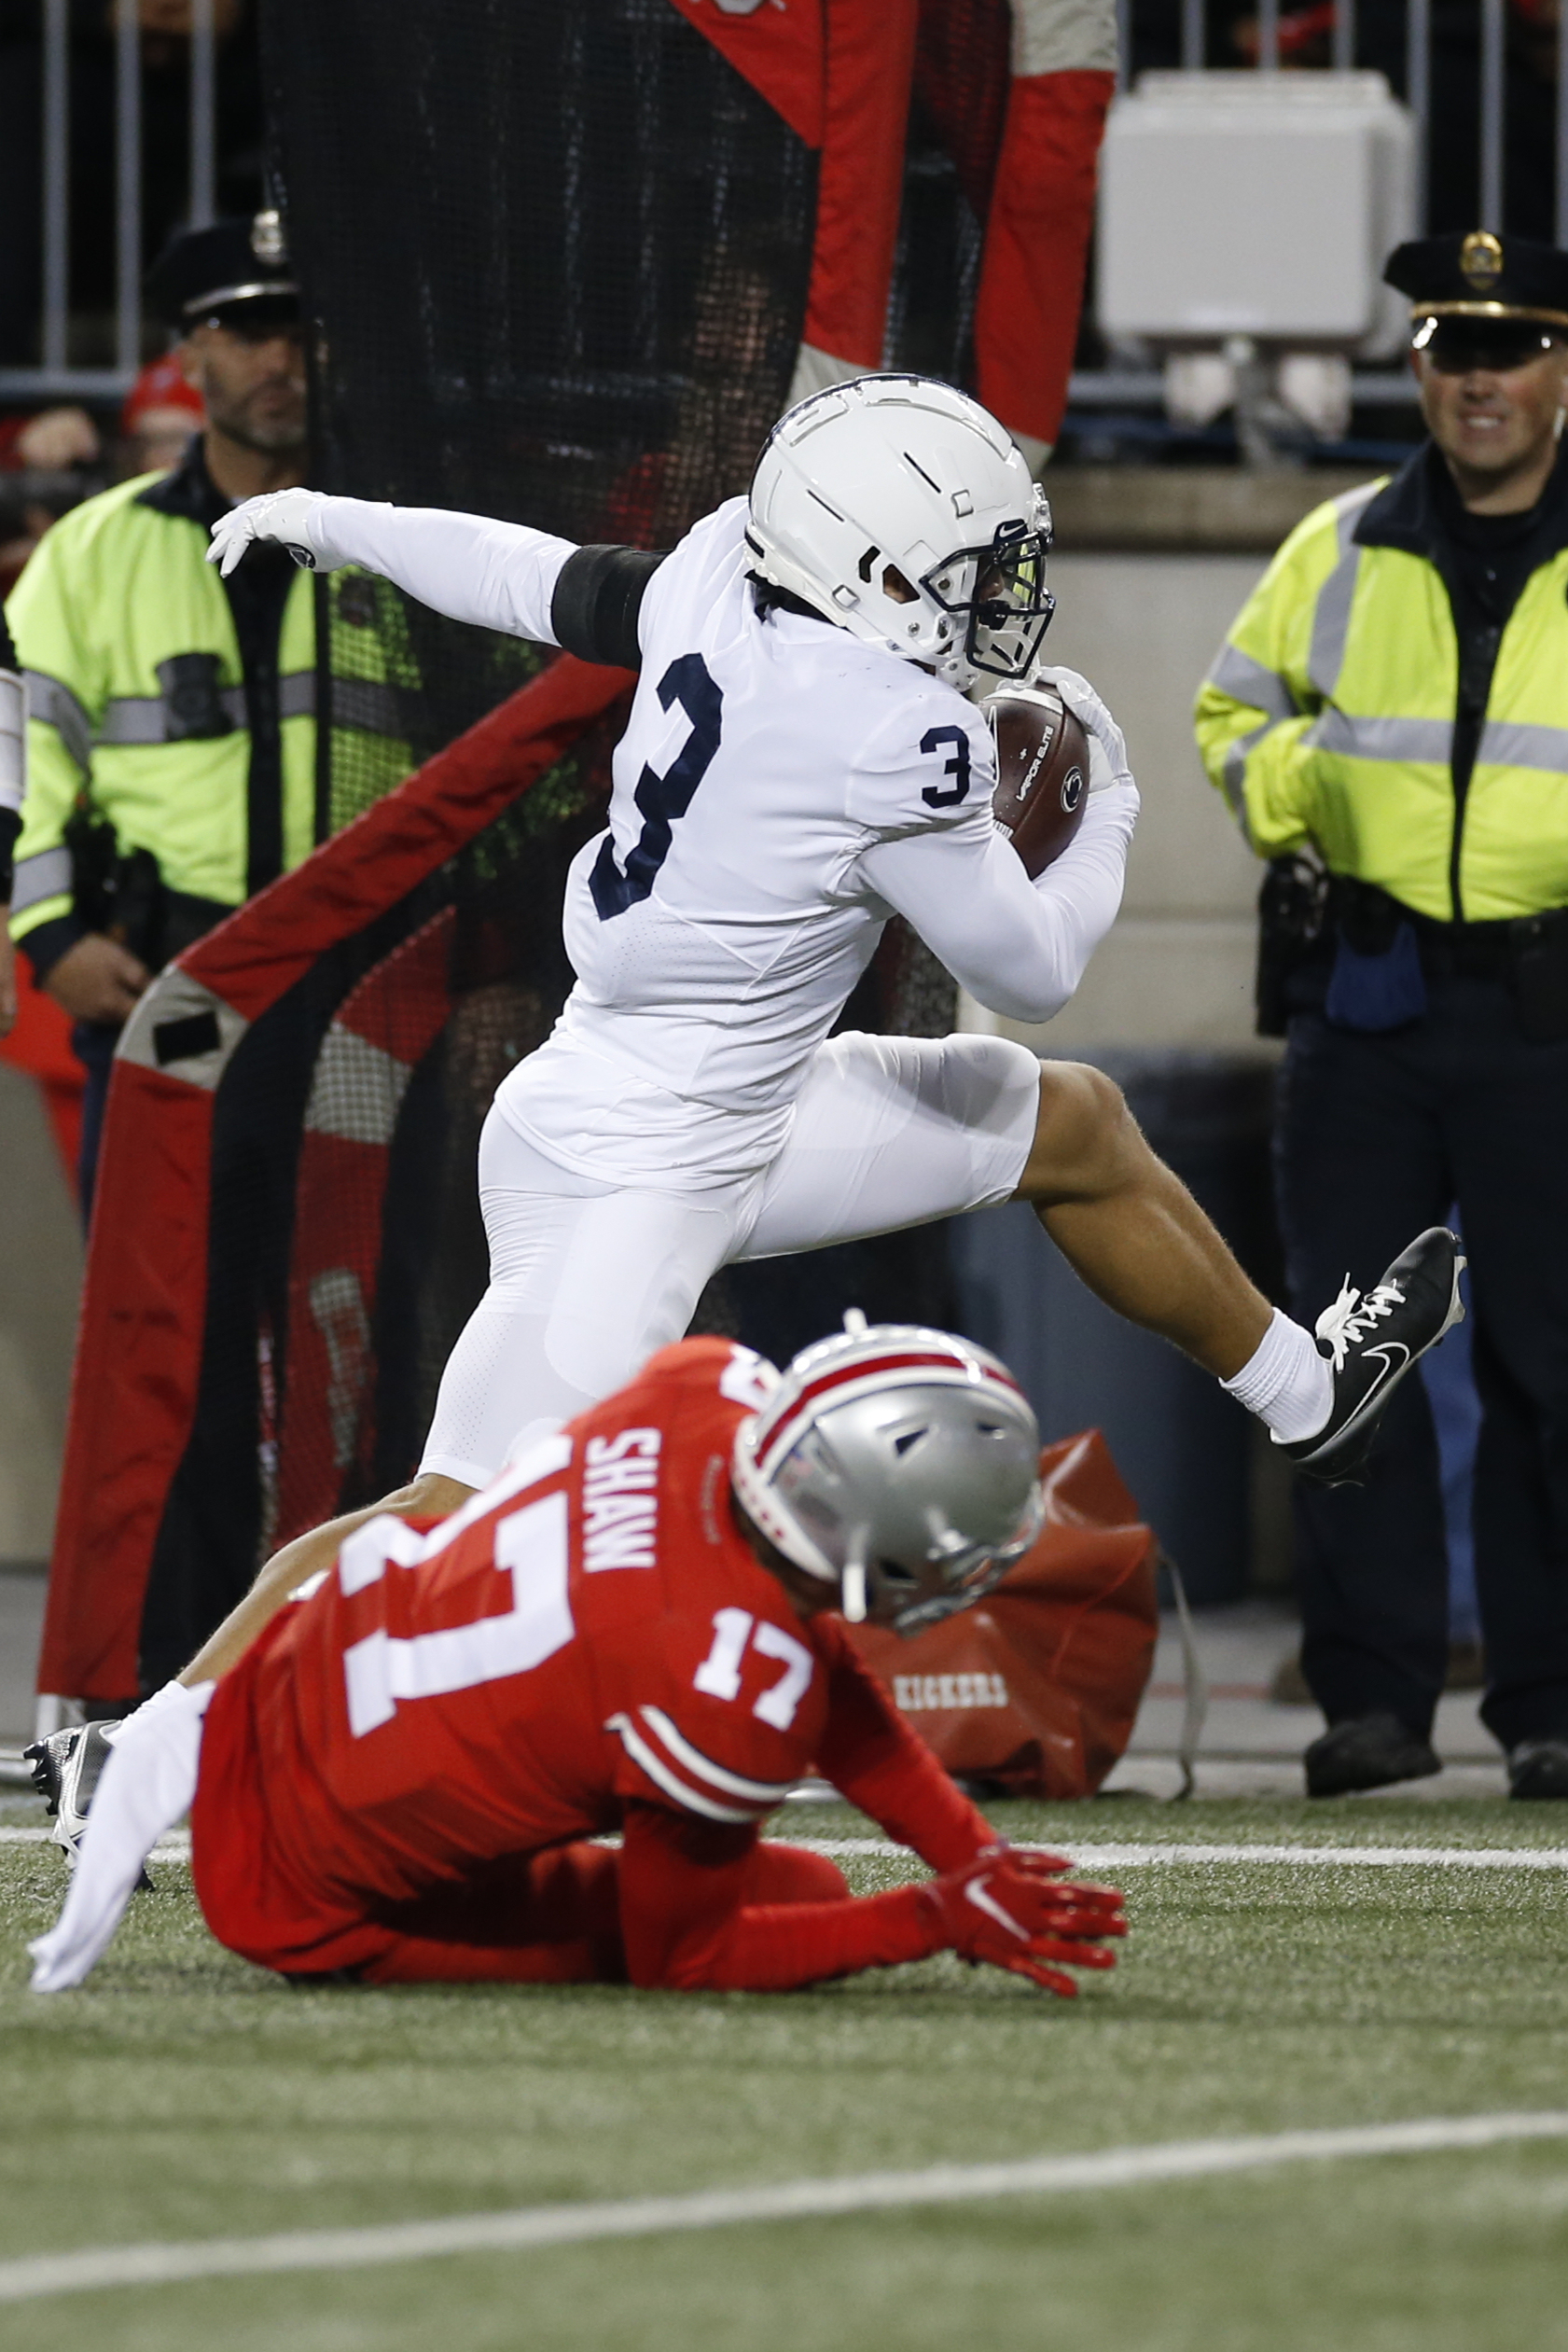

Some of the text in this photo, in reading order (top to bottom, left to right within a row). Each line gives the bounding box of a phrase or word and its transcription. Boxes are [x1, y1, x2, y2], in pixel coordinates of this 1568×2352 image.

[588, 651, 724, 922] 3
[919, 724, 972, 809] 3
[1016, 725, 1053, 800] VAPOR ELITE
[582, 1427, 661, 1574] SHAW
[340, 1433, 576, 1740] 17
[693, 1606, 814, 1733] 17
[893, 1671, 1008, 1710] KICKERS
